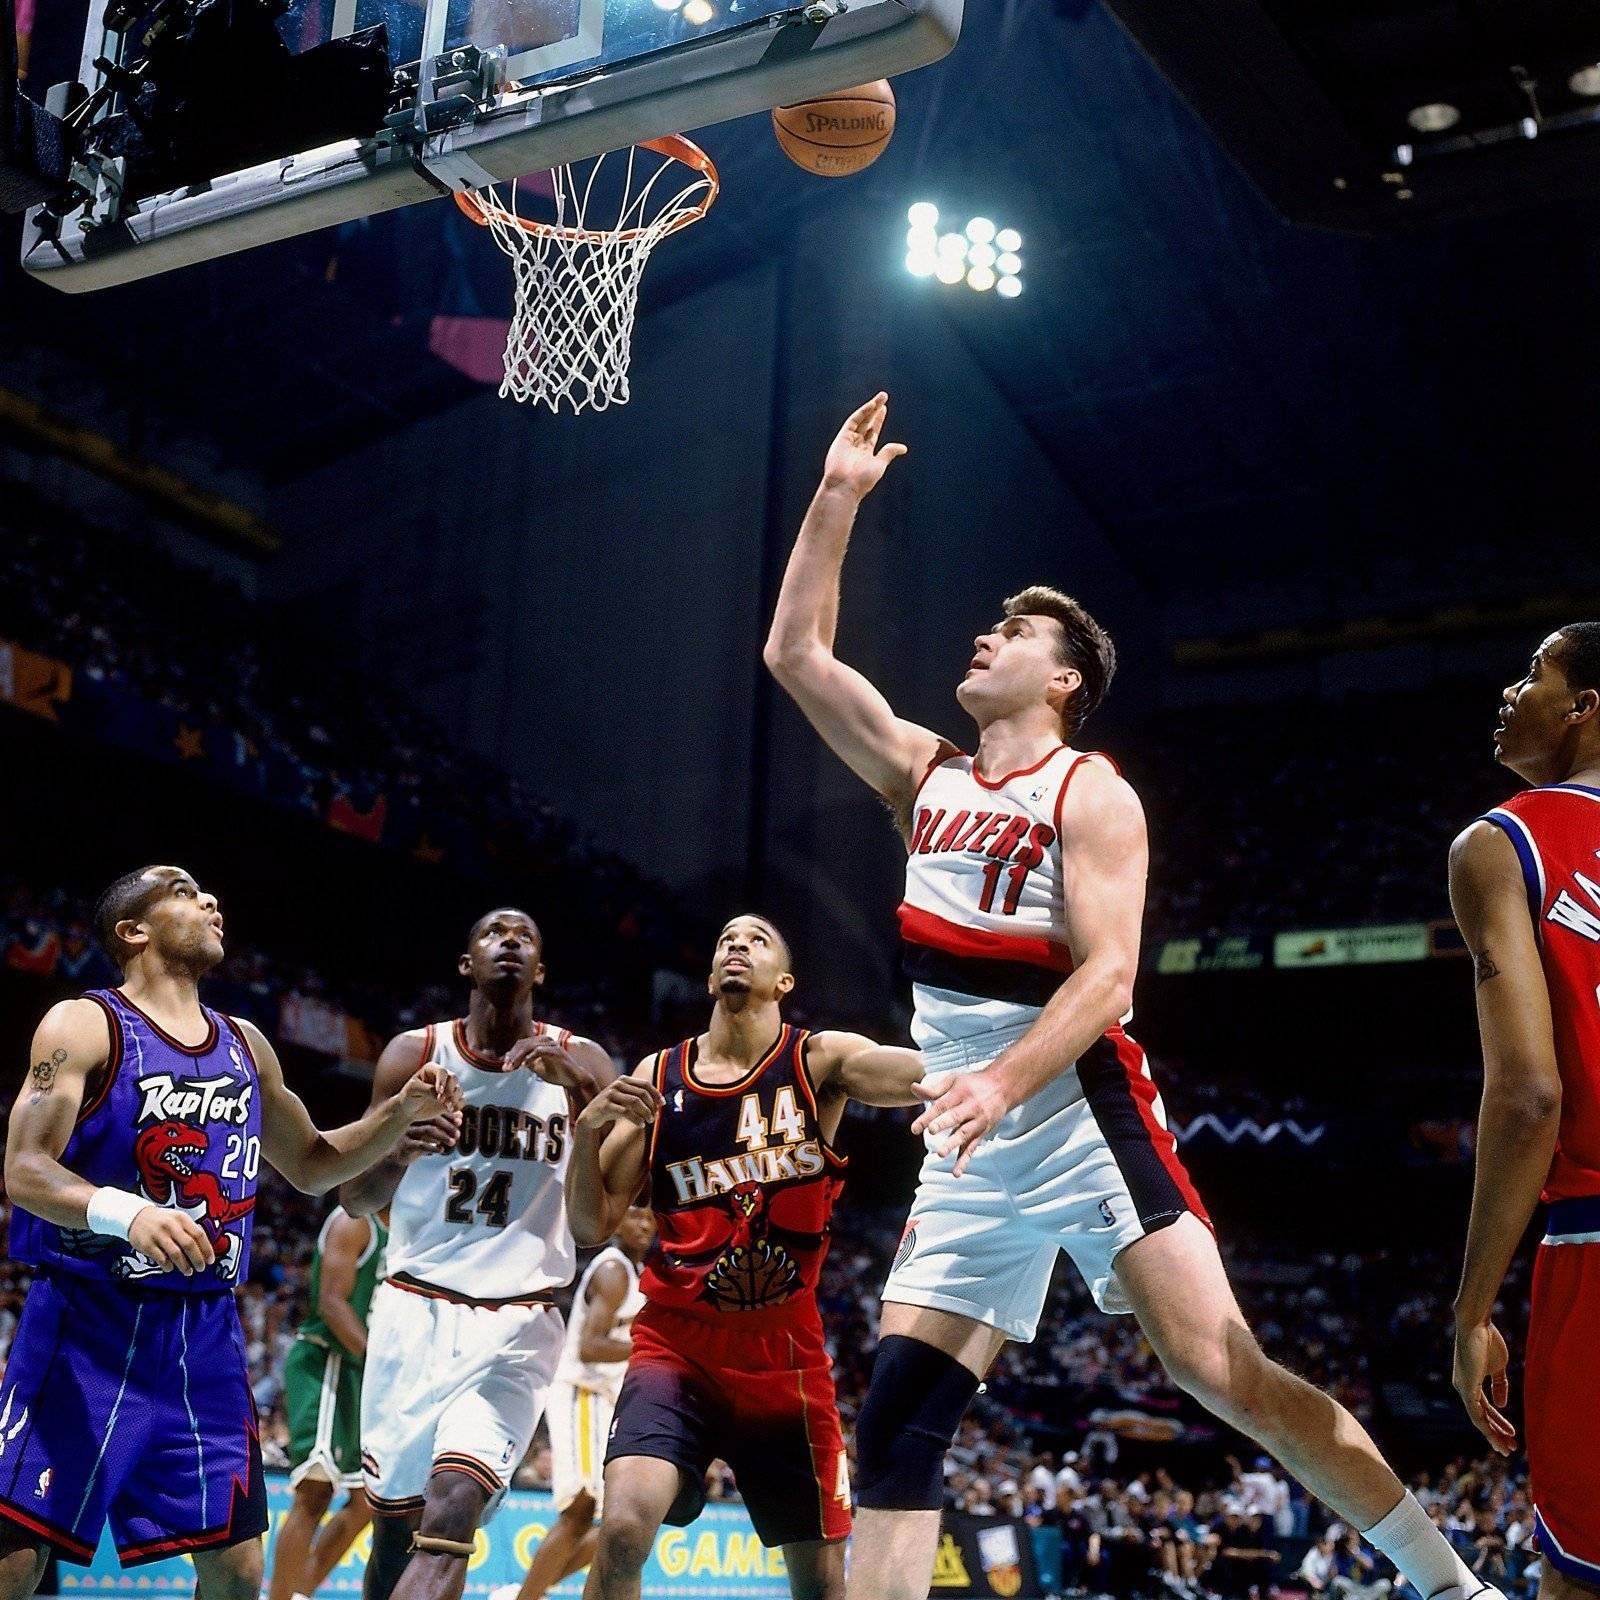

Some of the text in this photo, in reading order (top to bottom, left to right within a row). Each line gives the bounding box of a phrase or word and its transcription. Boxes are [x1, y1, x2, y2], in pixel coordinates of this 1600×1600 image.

[806, 111, 886, 133] SPALDING
[910, 808, 1057, 870] BLAZERS
[978, 859, 1030, 916] 11
[428, 1104, 569, 1165] GGETS
[735, 1084, 806, 1152] 44
[221, 1134, 261, 1181] 20
[665, 1139, 825, 1206] HAWKS
[444, 1166, 514, 1228] 24
